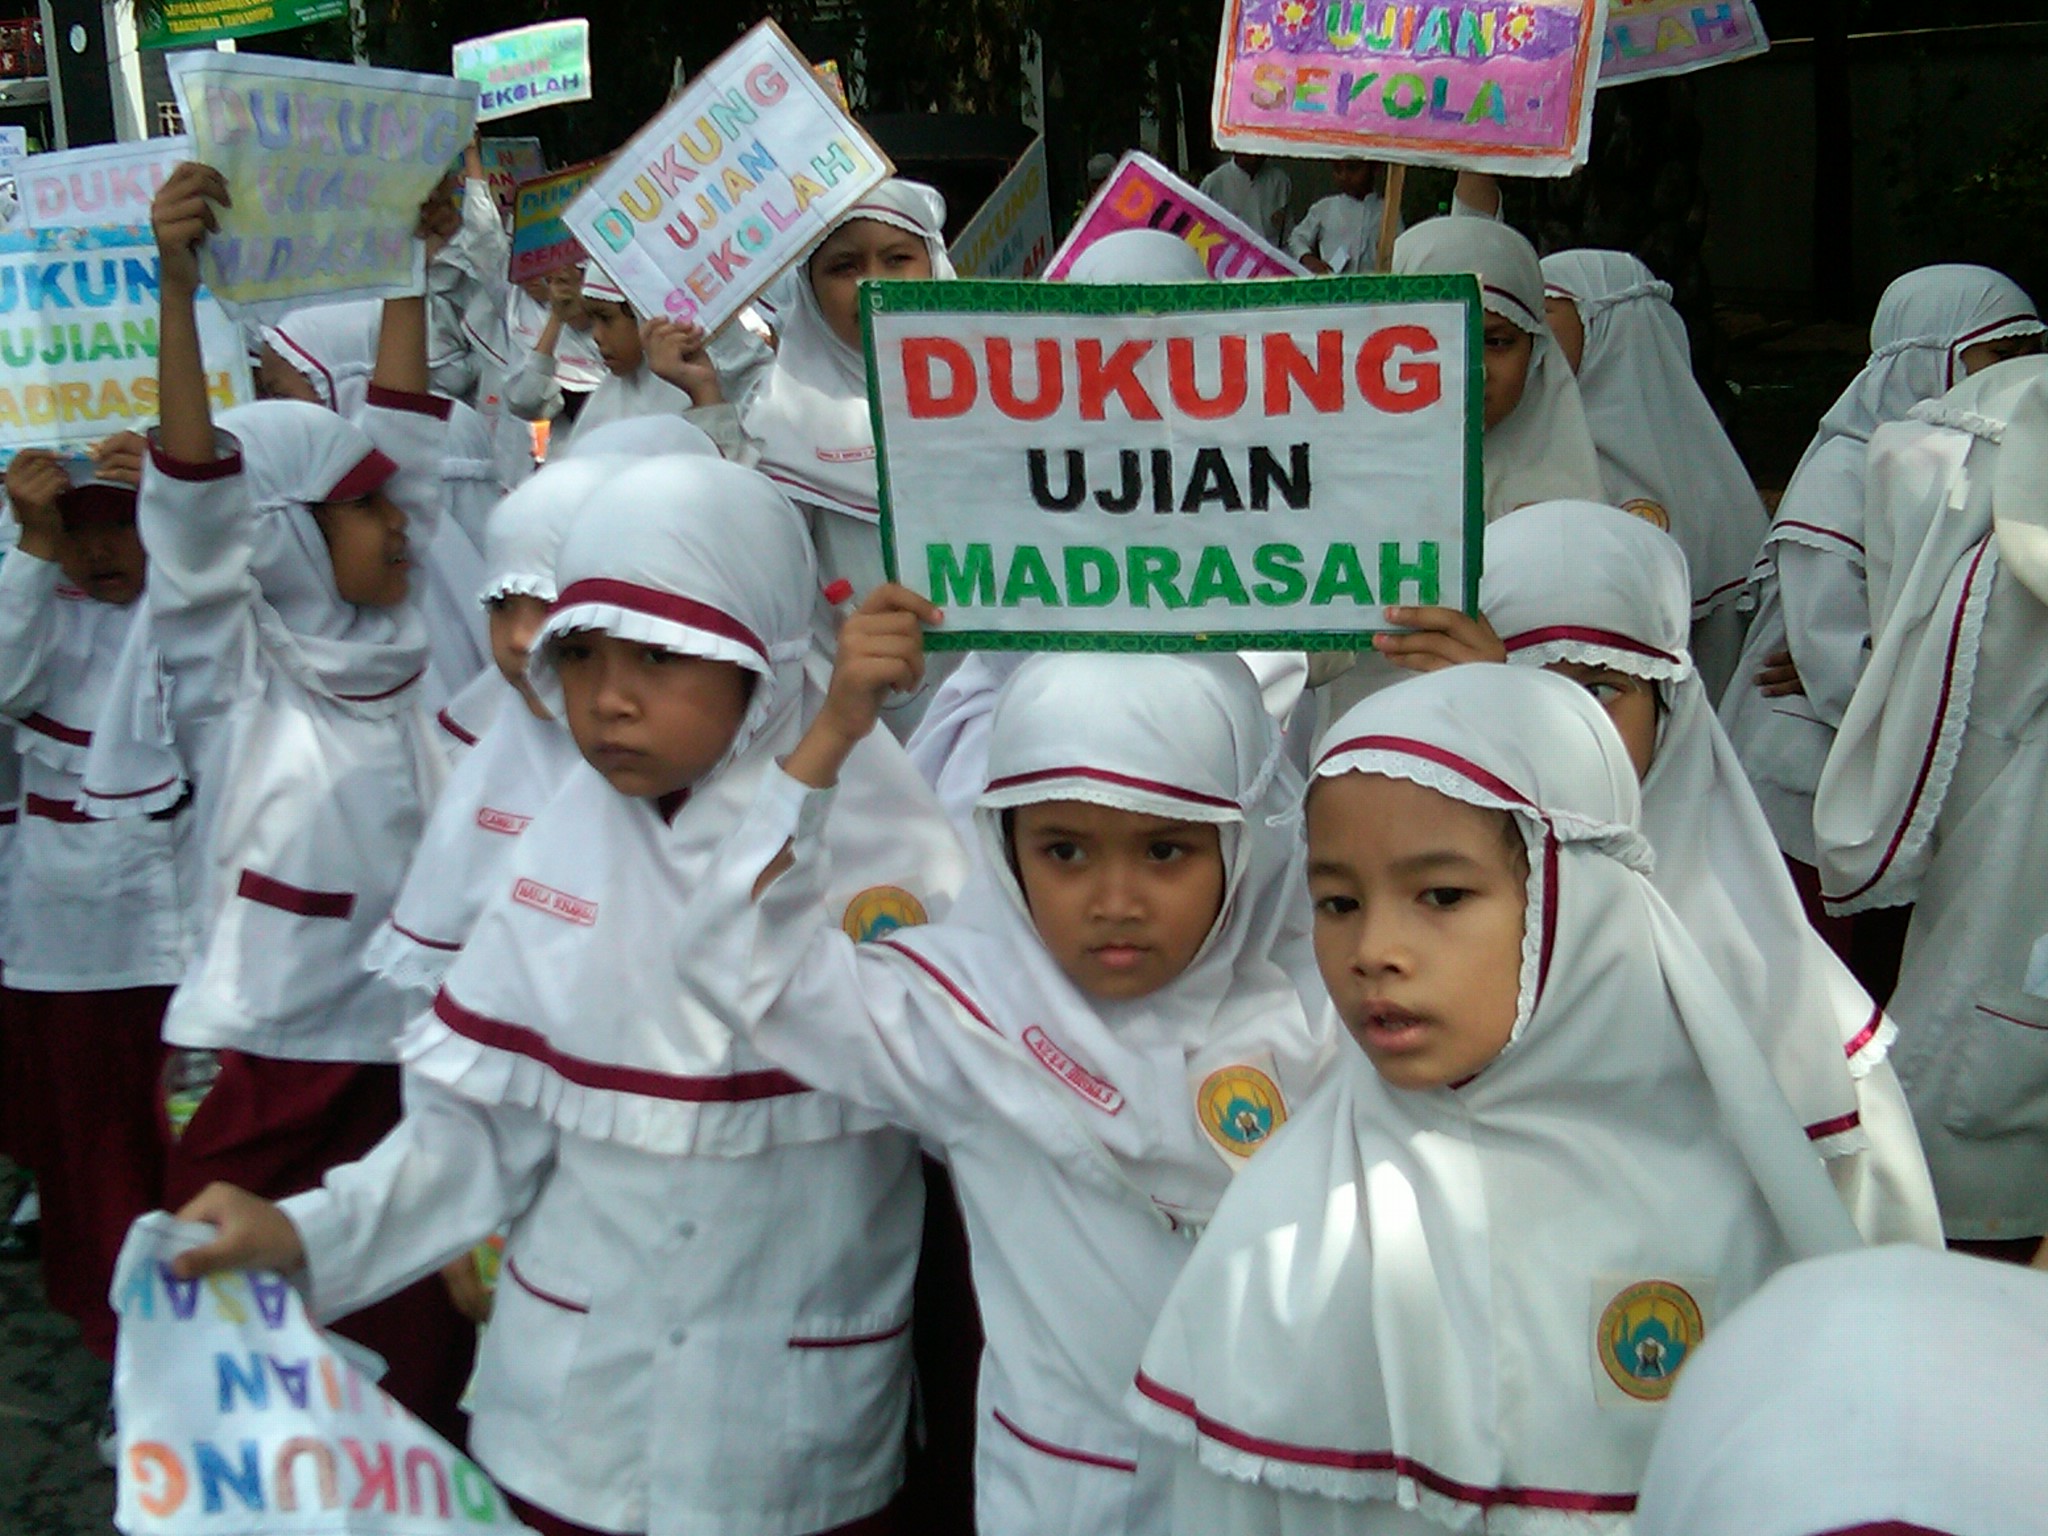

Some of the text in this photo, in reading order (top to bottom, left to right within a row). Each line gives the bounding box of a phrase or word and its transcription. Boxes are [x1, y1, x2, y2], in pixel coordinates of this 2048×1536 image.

[1326, 2, 1496, 57] UJIAN
[205, 84, 460, 167] DUKUNG
[480, 73, 580, 110] EKOLAH
[592, 62, 790, 254] DUKUNG
[664, 138, 779, 251] UJIAN
[664, 142, 857, 323] SEKOLAH
[901, 325, 1441, 421] DUKUNG
[1027, 442, 1312, 514] UJIAN
[926, 541, 1440, 609] MADRASAH
[128, 1435, 498, 1524] DUKUNG
